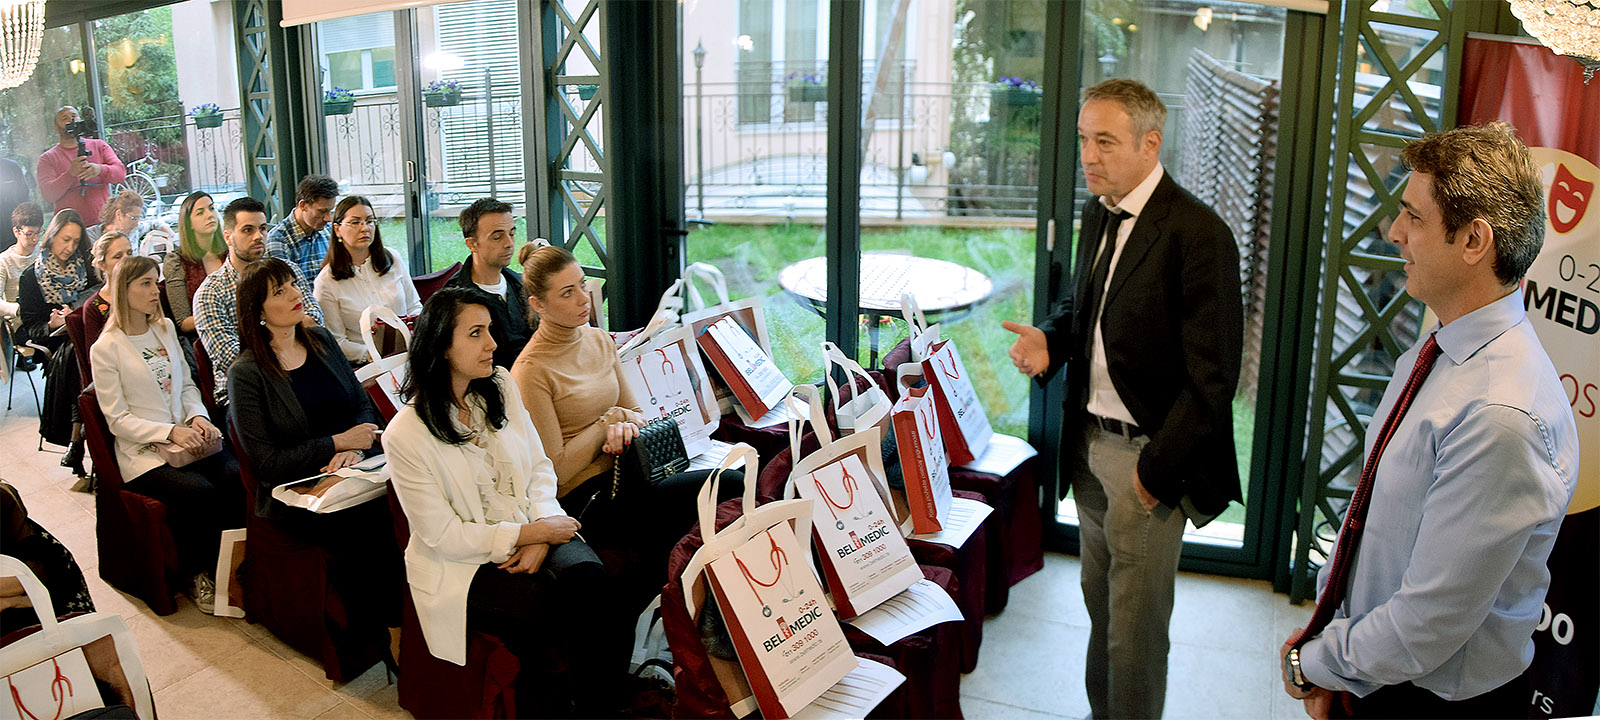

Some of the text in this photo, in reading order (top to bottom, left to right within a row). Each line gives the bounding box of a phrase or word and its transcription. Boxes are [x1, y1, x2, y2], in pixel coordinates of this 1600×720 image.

[837, 526, 890, 558] BEL MEDIC
[799, 599, 817, 613] 0-24h
[763, 606, 822, 653] BEL MEDIC
